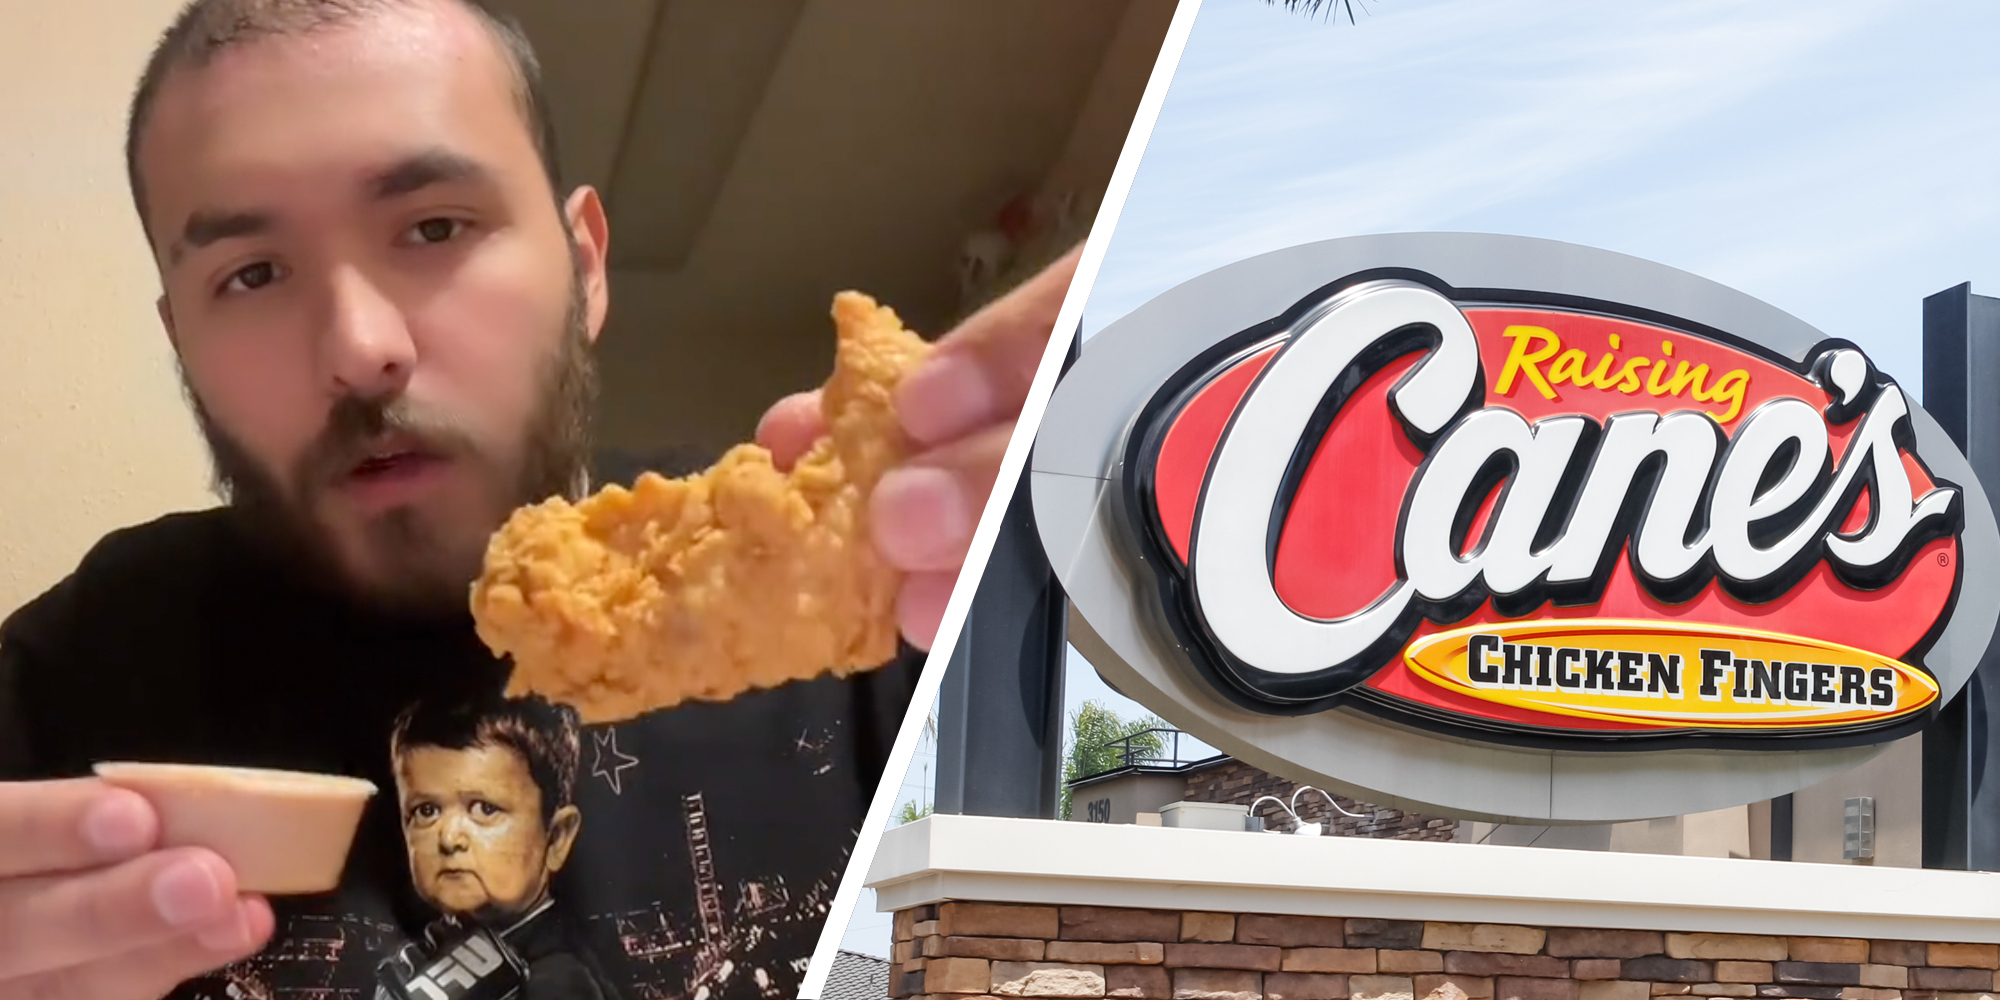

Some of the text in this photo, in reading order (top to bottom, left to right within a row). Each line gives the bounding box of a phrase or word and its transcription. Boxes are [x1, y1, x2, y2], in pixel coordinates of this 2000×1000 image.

[1494, 325, 1750, 424] Raising
[1191, 280, 1958, 675] Cane's
[1468, 634, 1895, 706] CHICKEN FINGERS
[1087, 798, 1110, 823] 3150
